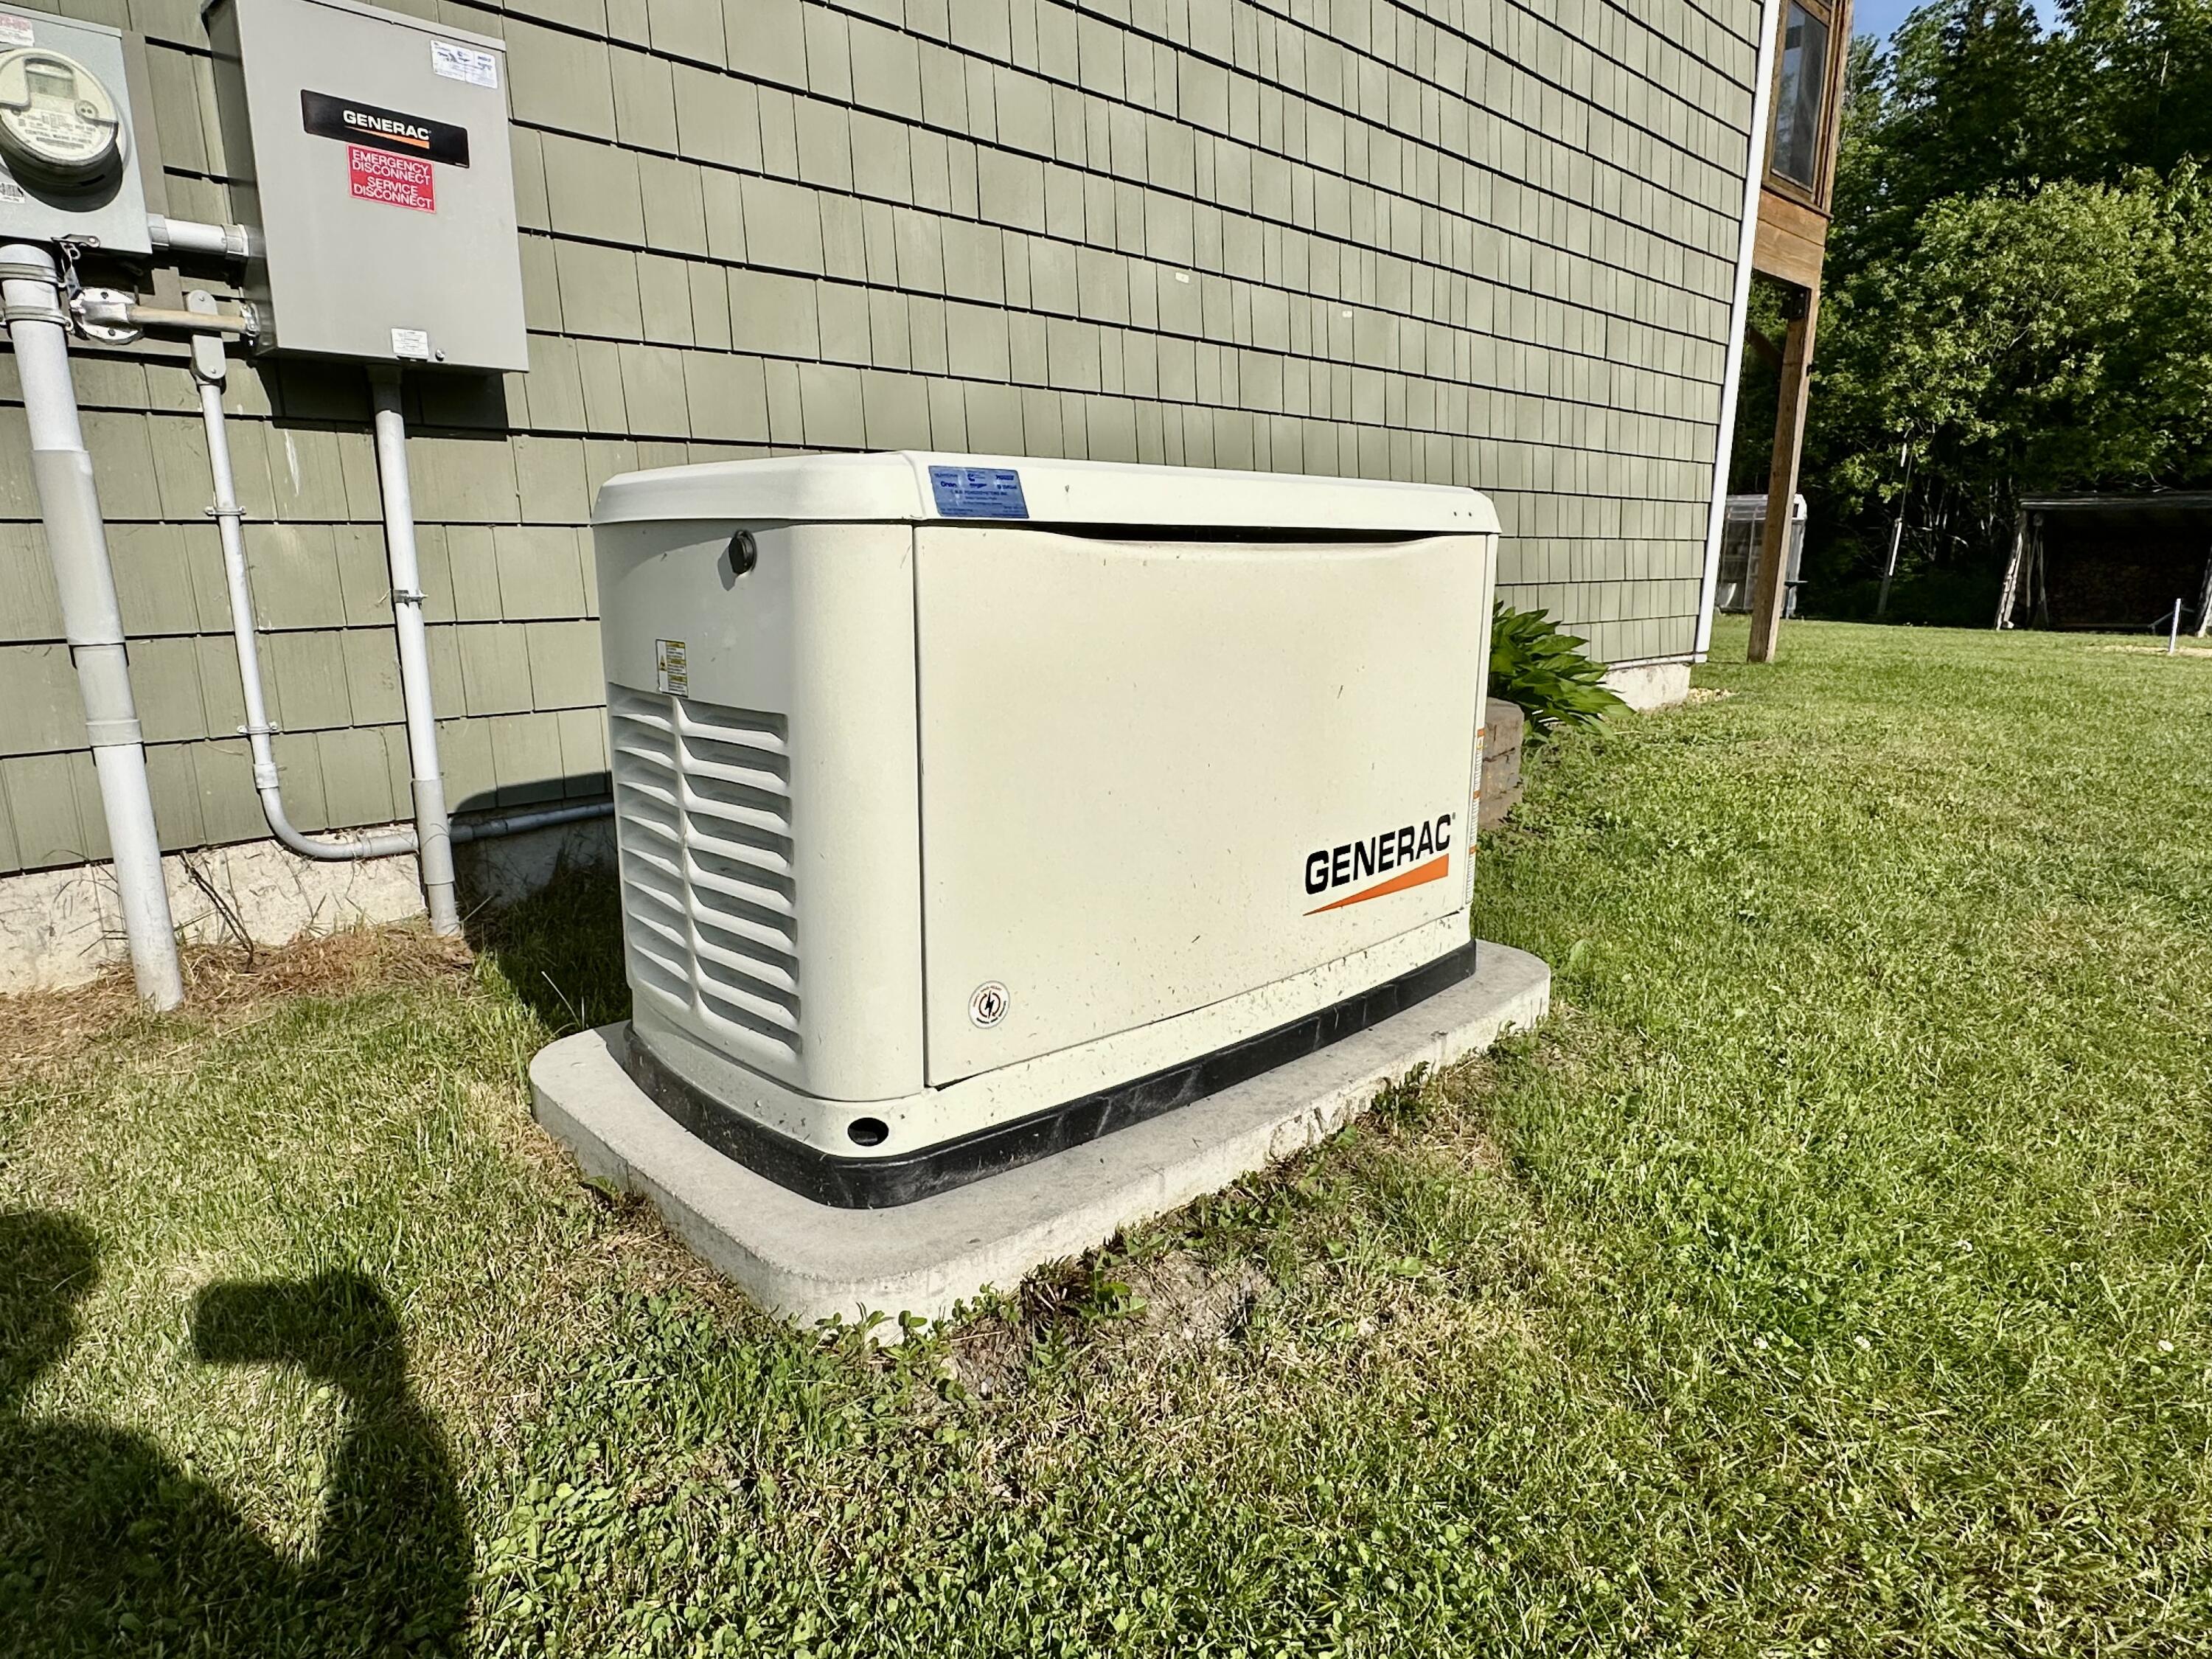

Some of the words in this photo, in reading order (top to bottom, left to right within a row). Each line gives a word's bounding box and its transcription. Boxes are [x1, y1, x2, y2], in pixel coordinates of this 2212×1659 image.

[343, 110, 430, 140] GENERAC
[352, 149, 428, 175] EMERGENCY
[352, 160, 431, 185] DISCONNECT
[353, 183, 432, 209] DISCONNECT
[367, 175, 418, 197] SERVICE
[1305, 814, 1450, 895] GENERAC
